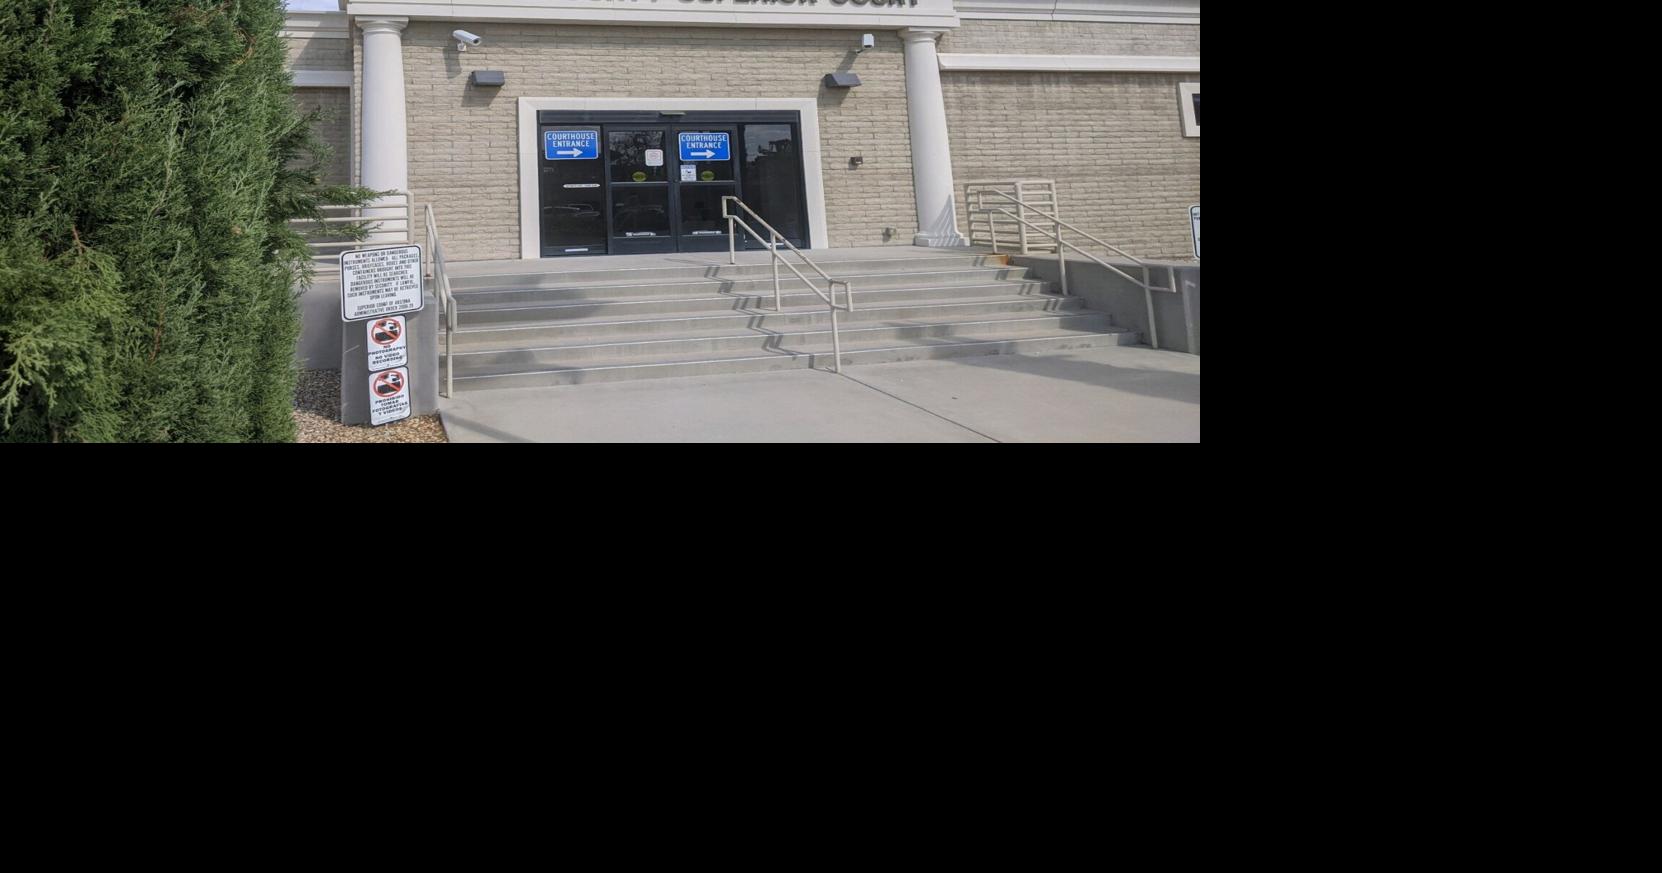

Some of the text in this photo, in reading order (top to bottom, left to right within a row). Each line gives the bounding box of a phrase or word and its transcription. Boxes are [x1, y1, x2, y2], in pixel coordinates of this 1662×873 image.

[354, 308, 384, 316] ADMINISTRATIVE
[368, 346, 406, 355] PHOTOGRAPHY
[372, 356, 402, 364] RECORDING
[375, 394, 404, 404] PROHIBIDO
